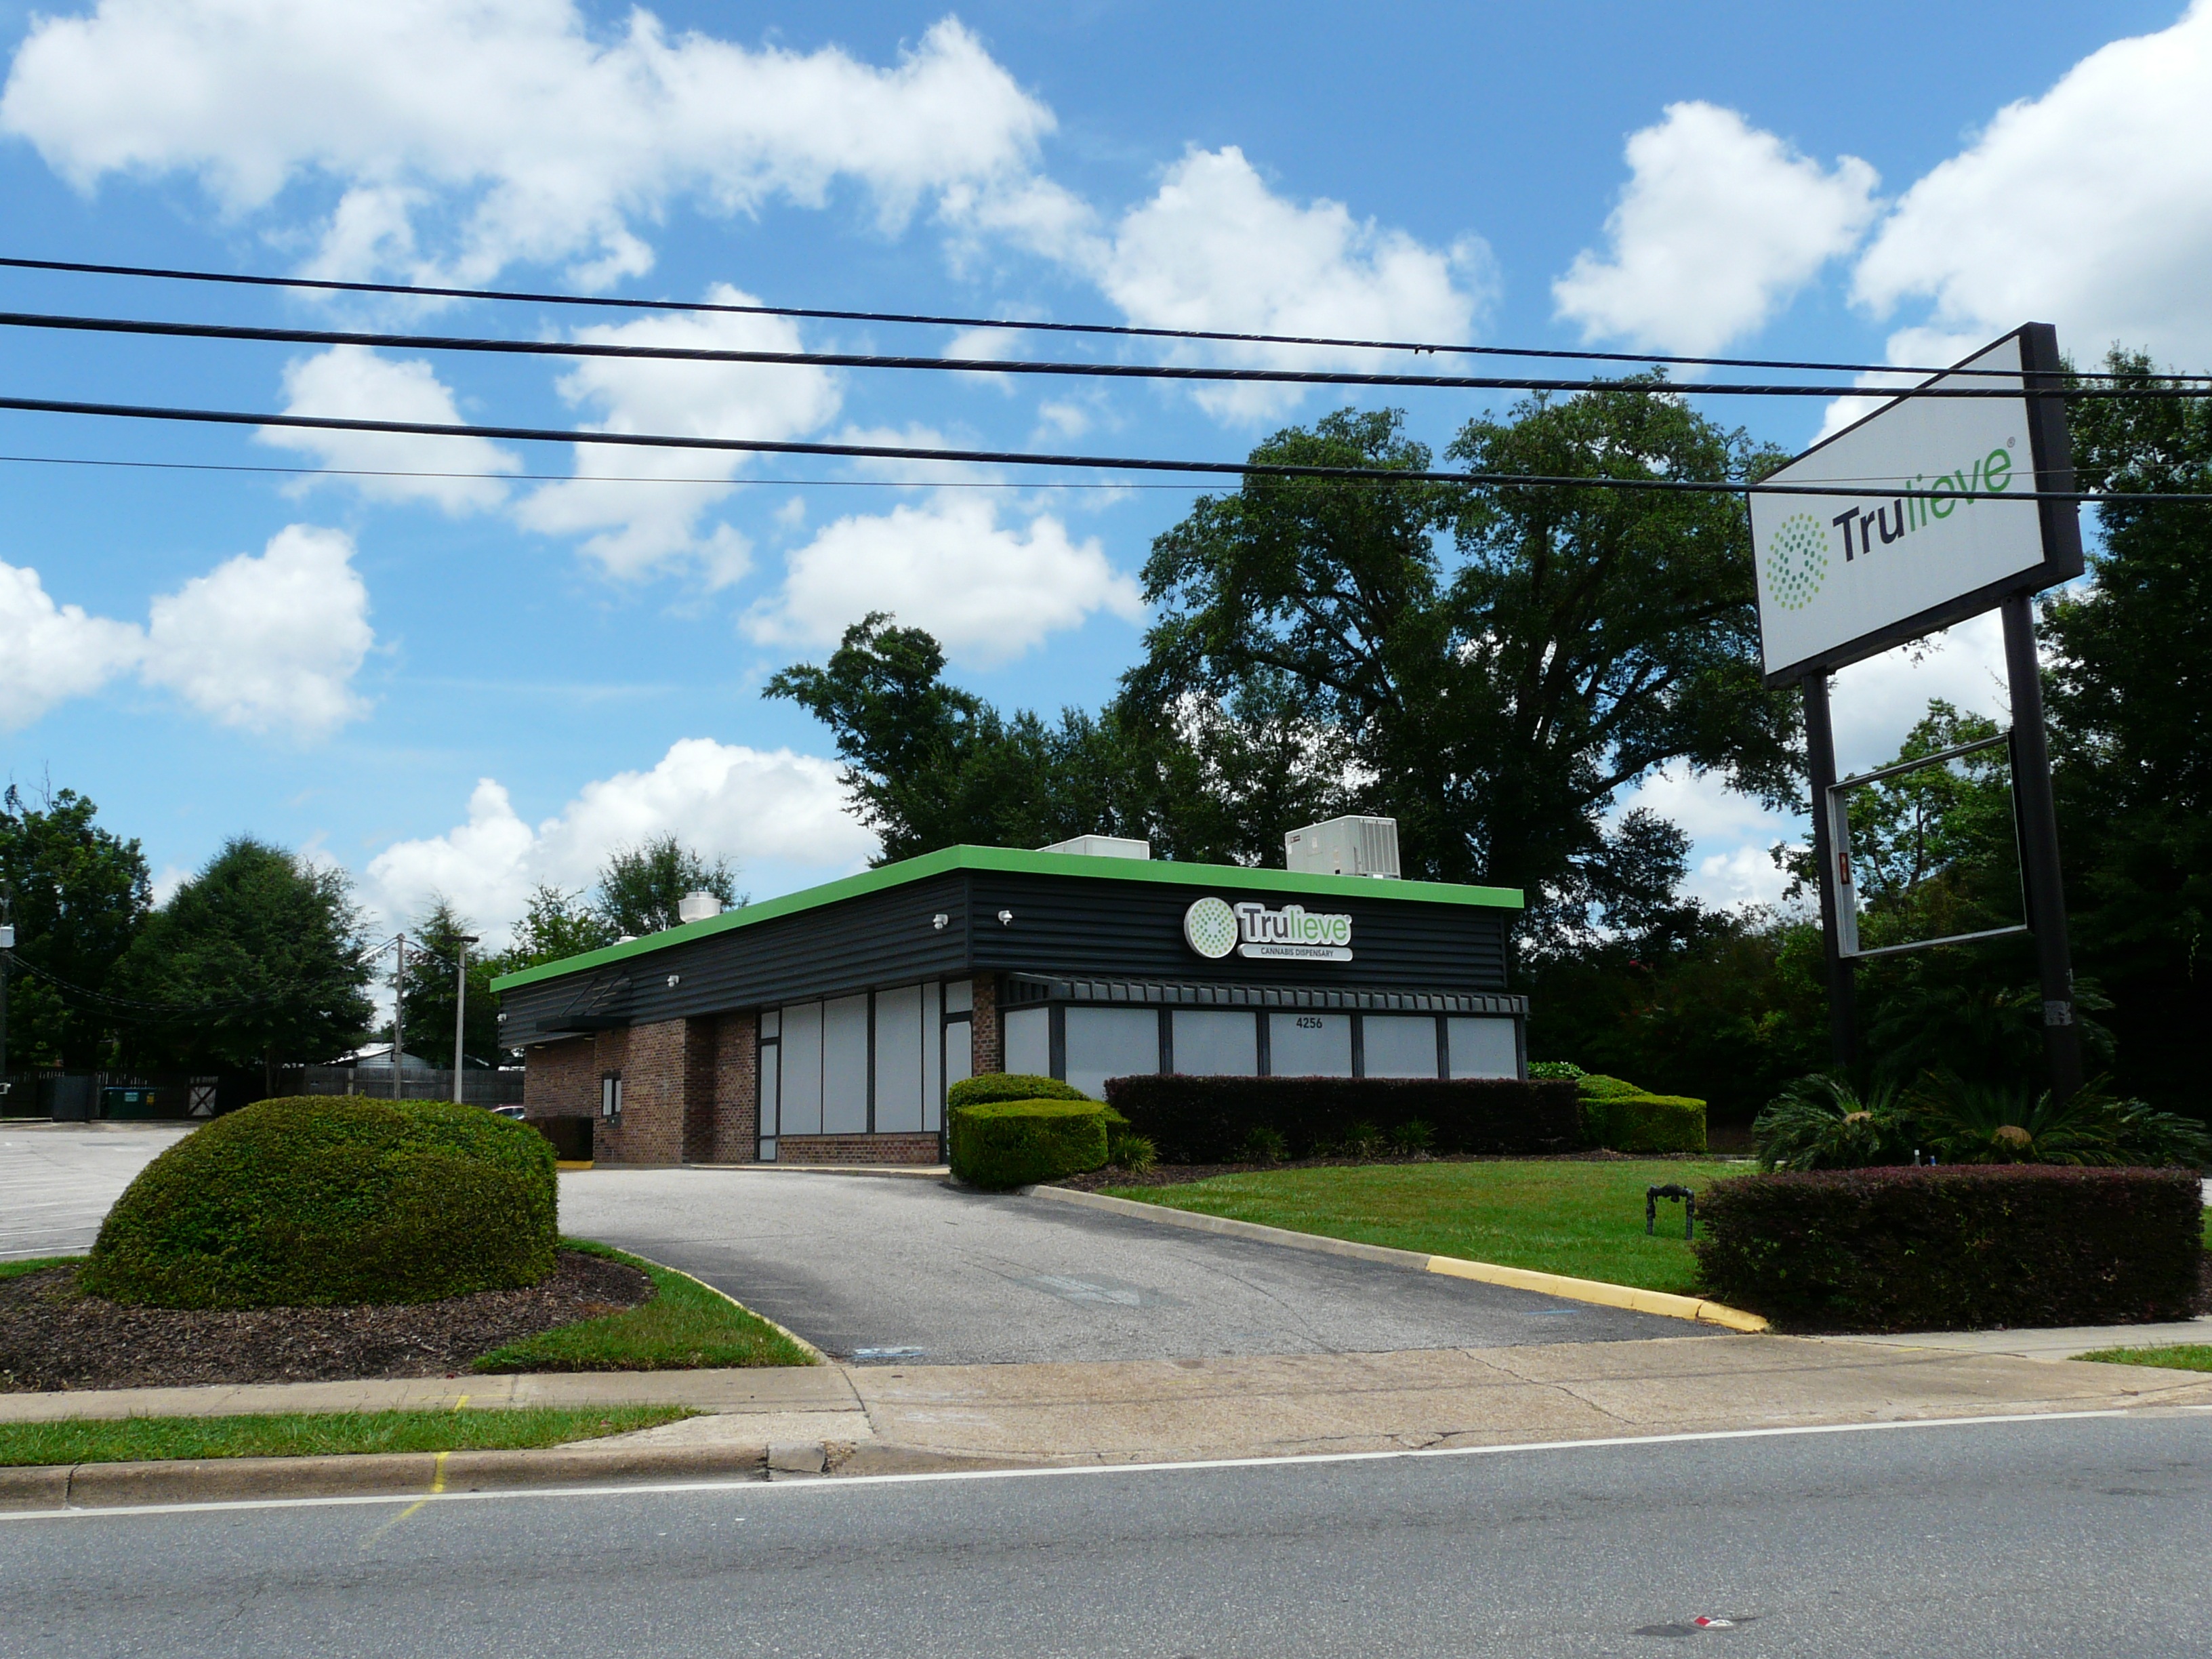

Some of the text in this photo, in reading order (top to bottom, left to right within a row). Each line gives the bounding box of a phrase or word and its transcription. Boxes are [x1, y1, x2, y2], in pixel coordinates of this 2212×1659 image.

[1832, 448, 2012, 562] Trulieve
[1242, 907, 1347, 941] Trulieve
[1261, 947, 1334, 958] CANNABIS DISPENSARY
[1296, 1017, 1323, 1029] 4256
